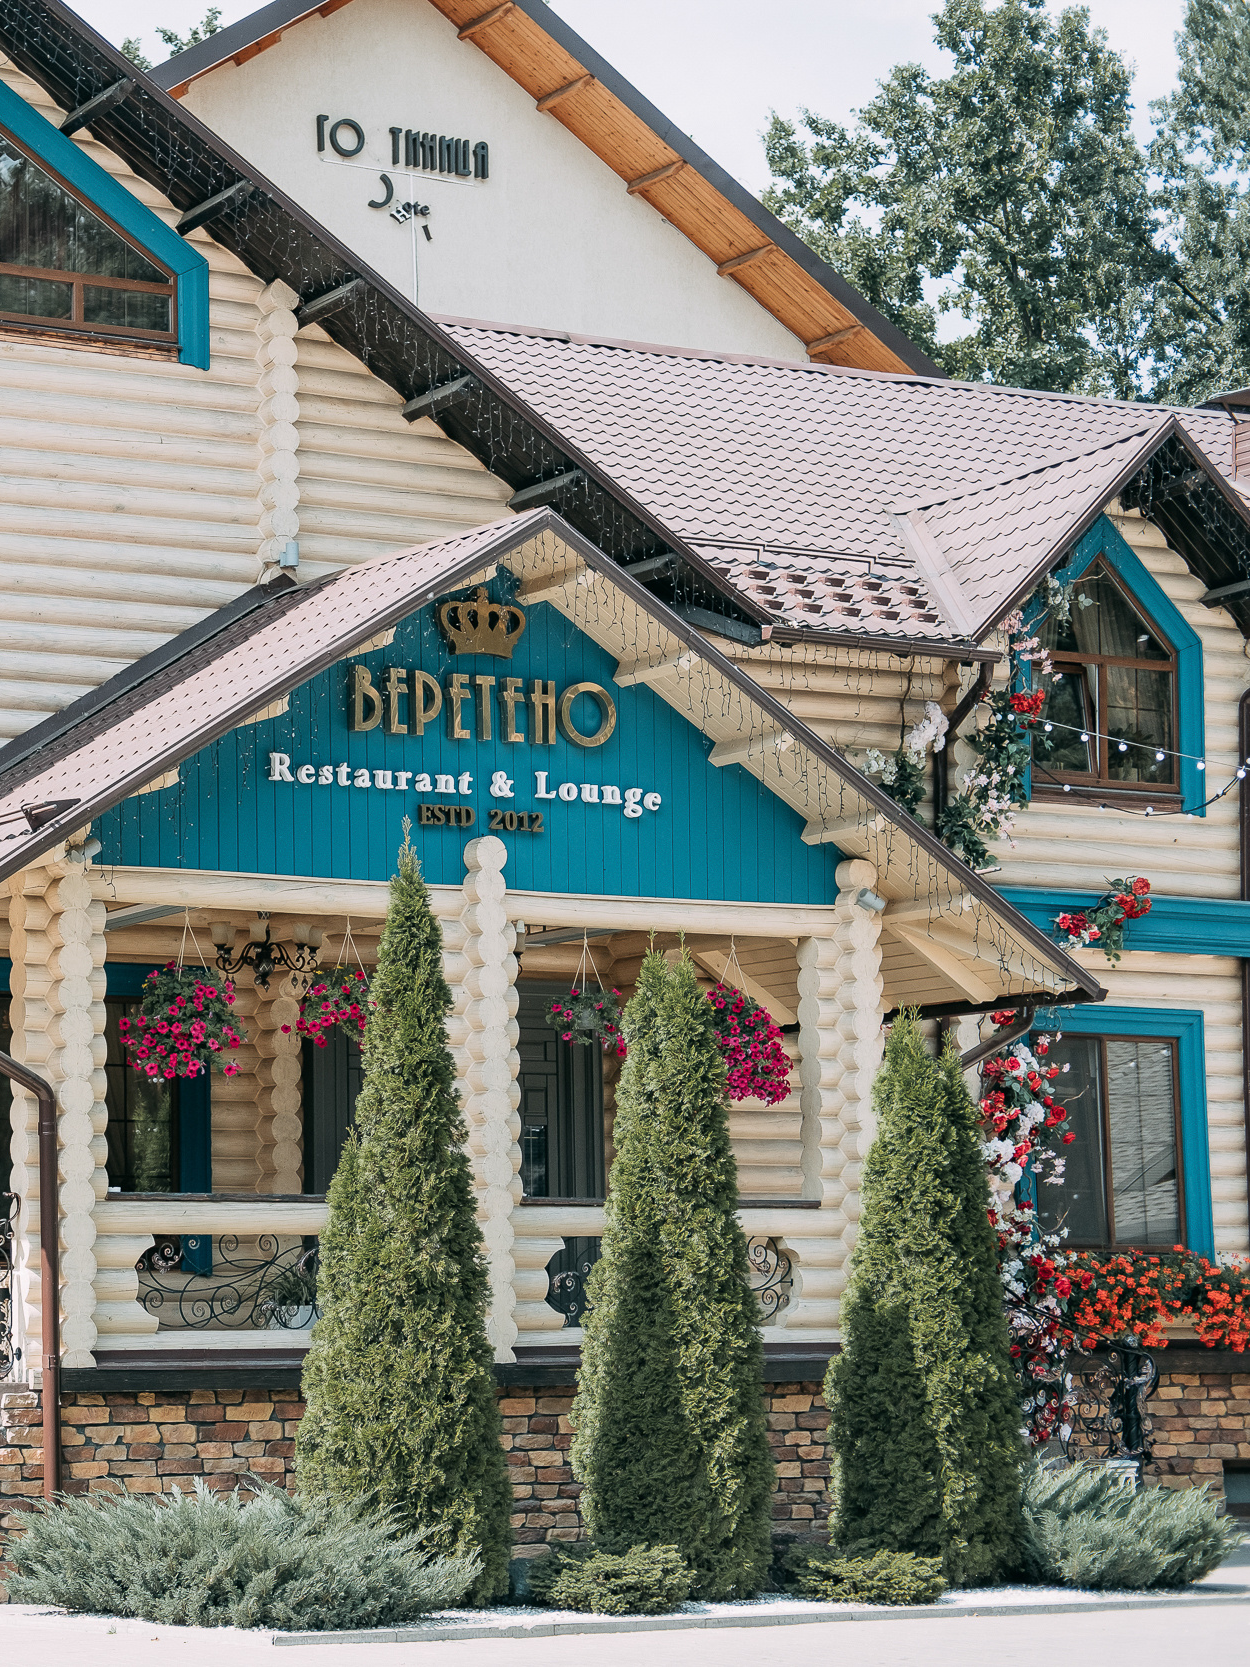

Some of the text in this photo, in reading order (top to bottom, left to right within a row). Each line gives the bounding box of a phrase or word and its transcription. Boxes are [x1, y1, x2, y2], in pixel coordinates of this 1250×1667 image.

[349, 664, 617, 747] ВЕРЕТЕНО
[269, 752, 662, 818] Restaurant & Lounge
[418, 803, 545, 833] ESTD 2012
